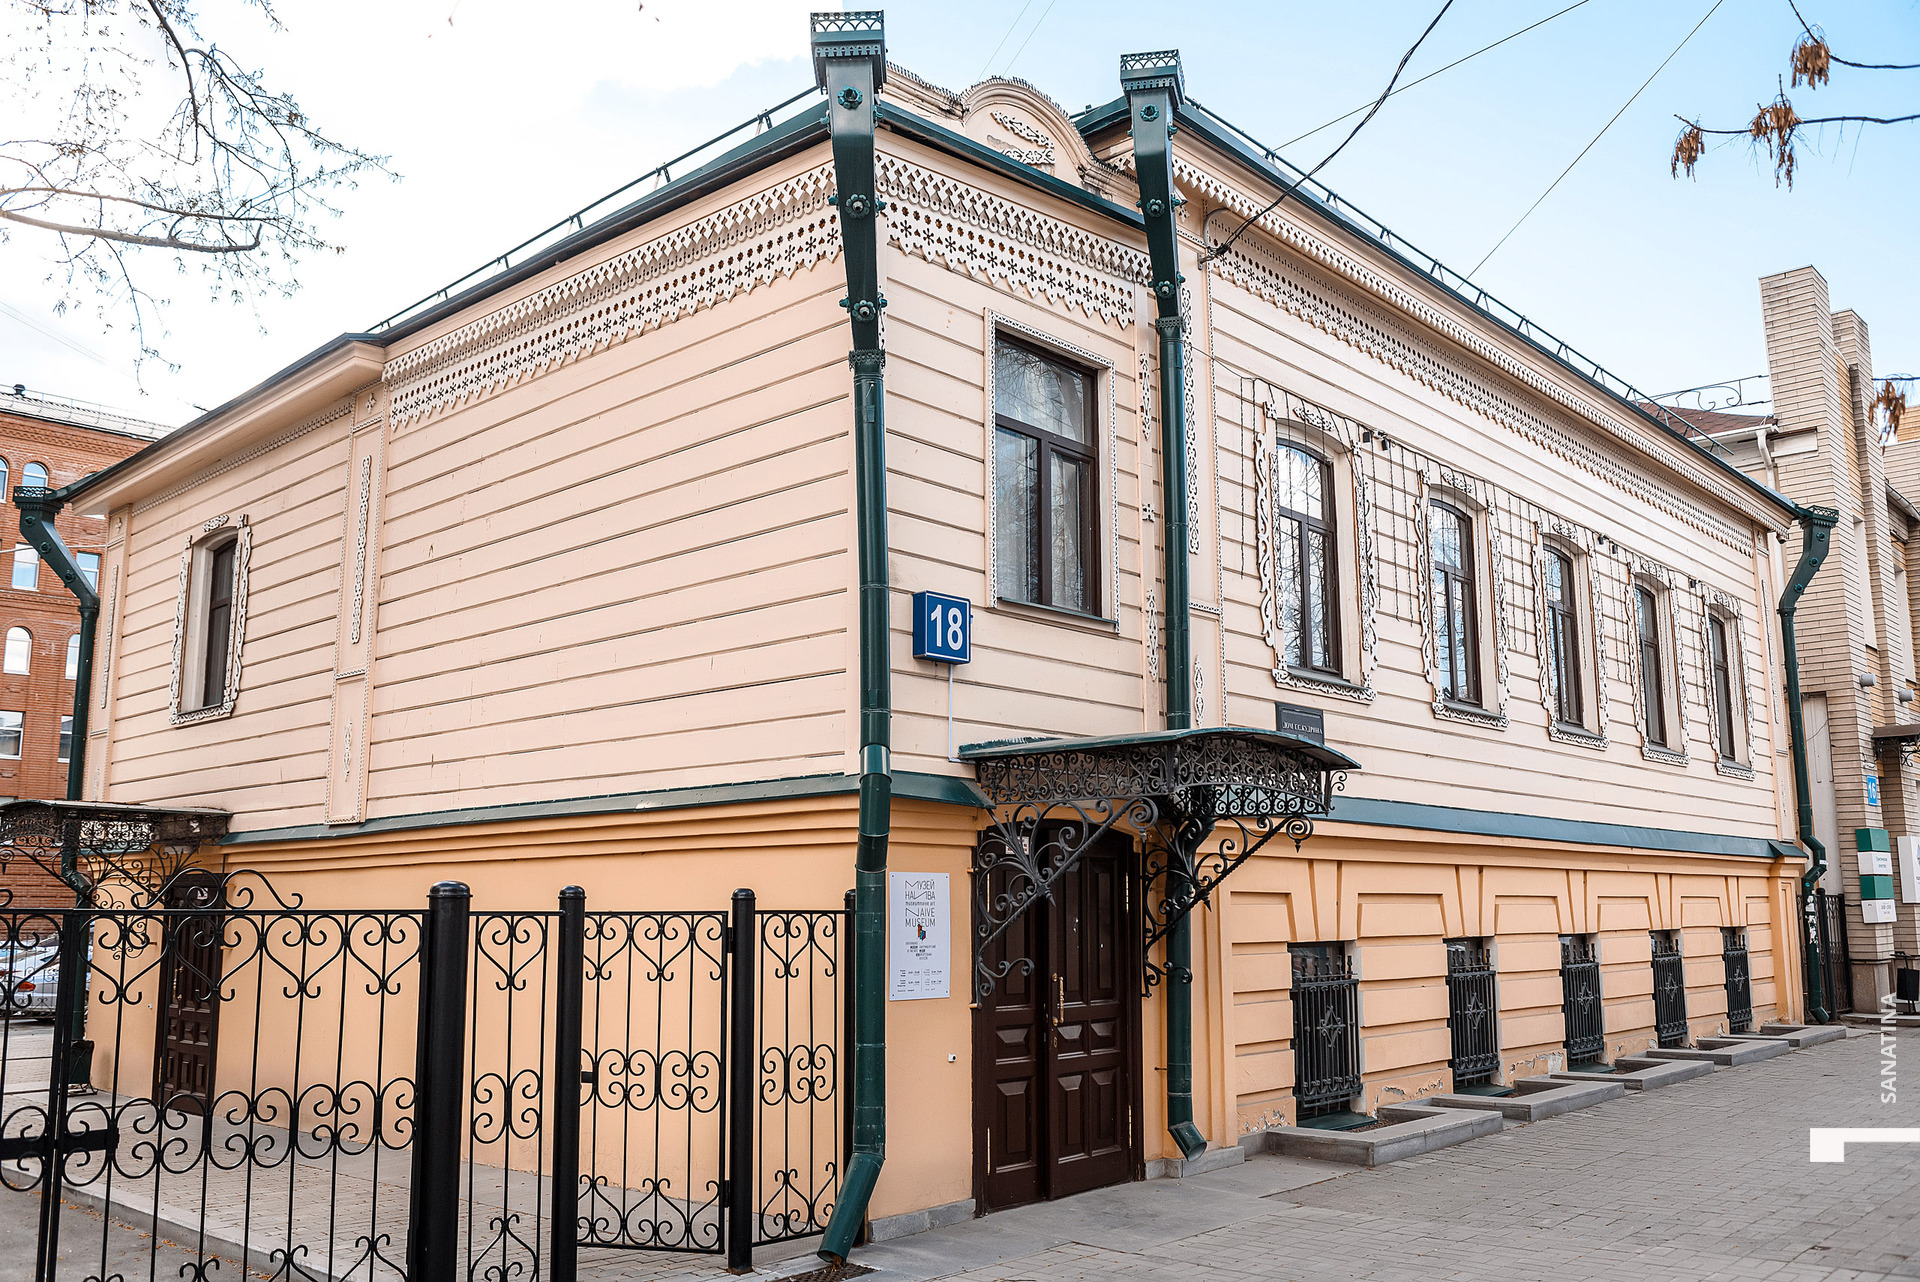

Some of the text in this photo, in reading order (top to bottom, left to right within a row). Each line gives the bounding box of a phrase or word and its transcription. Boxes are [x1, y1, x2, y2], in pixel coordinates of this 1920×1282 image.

[930, 604, 963, 651] 18
[1868, 782, 1877, 799] 16
[905, 879, 935, 890] МУЗЕЙ
[905, 890, 936, 900] НАИВА
[905, 907, 935, 917] NAIVE
[905, 918, 936, 927] MUSEUM
